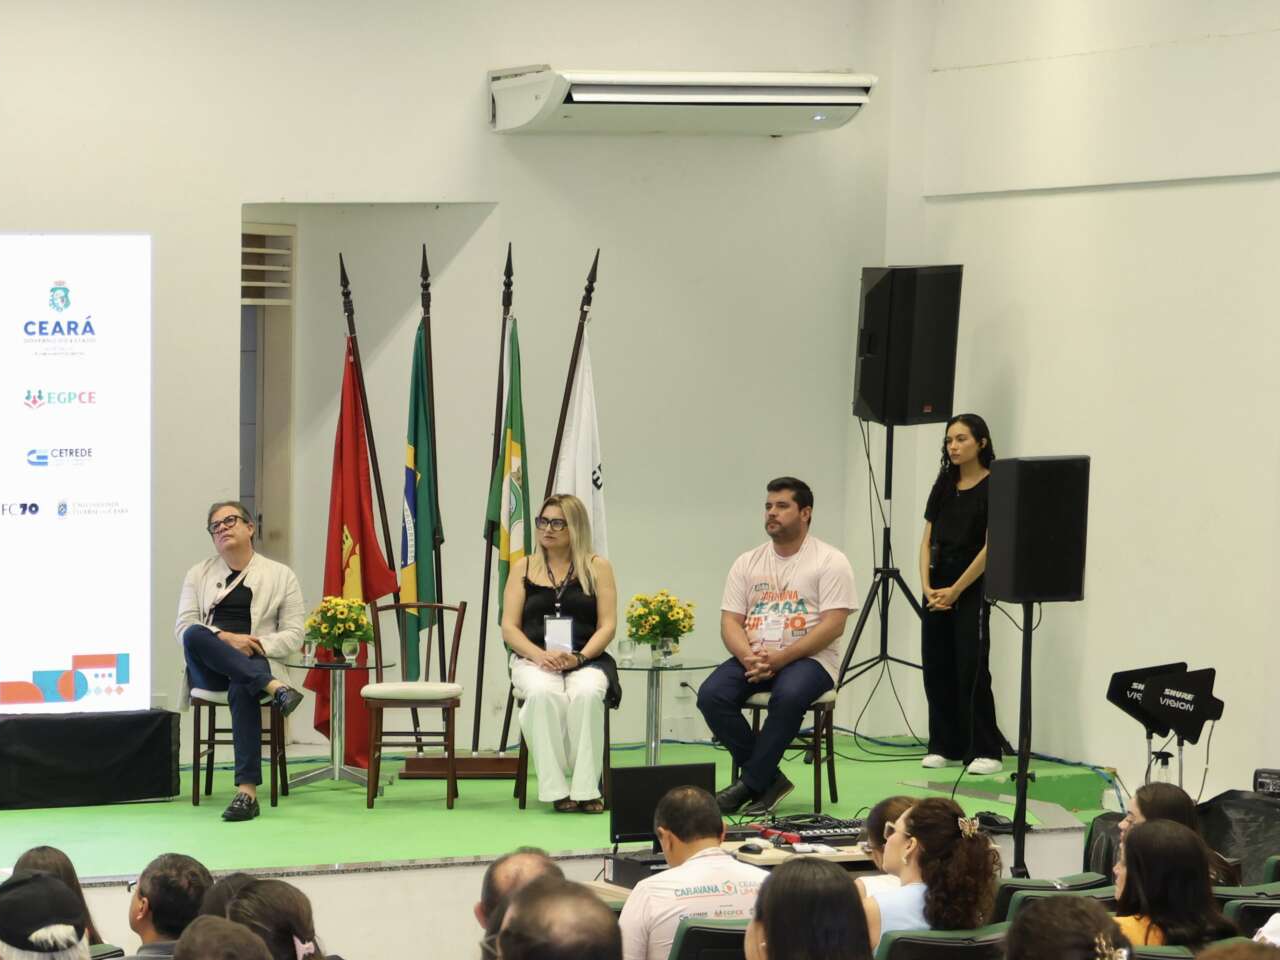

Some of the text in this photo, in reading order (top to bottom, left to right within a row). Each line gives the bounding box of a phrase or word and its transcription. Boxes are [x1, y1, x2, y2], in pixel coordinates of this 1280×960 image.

[23, 315, 96, 336] CEARÁ
[47, 391, 97, 404] EGPCE
[50, 448, 93, 458] CETREDE
[1163, 687, 1195, 701] SHURE
[1160, 696, 1194, 712] VISION
[674, 884, 721, 897] CARAVANA
